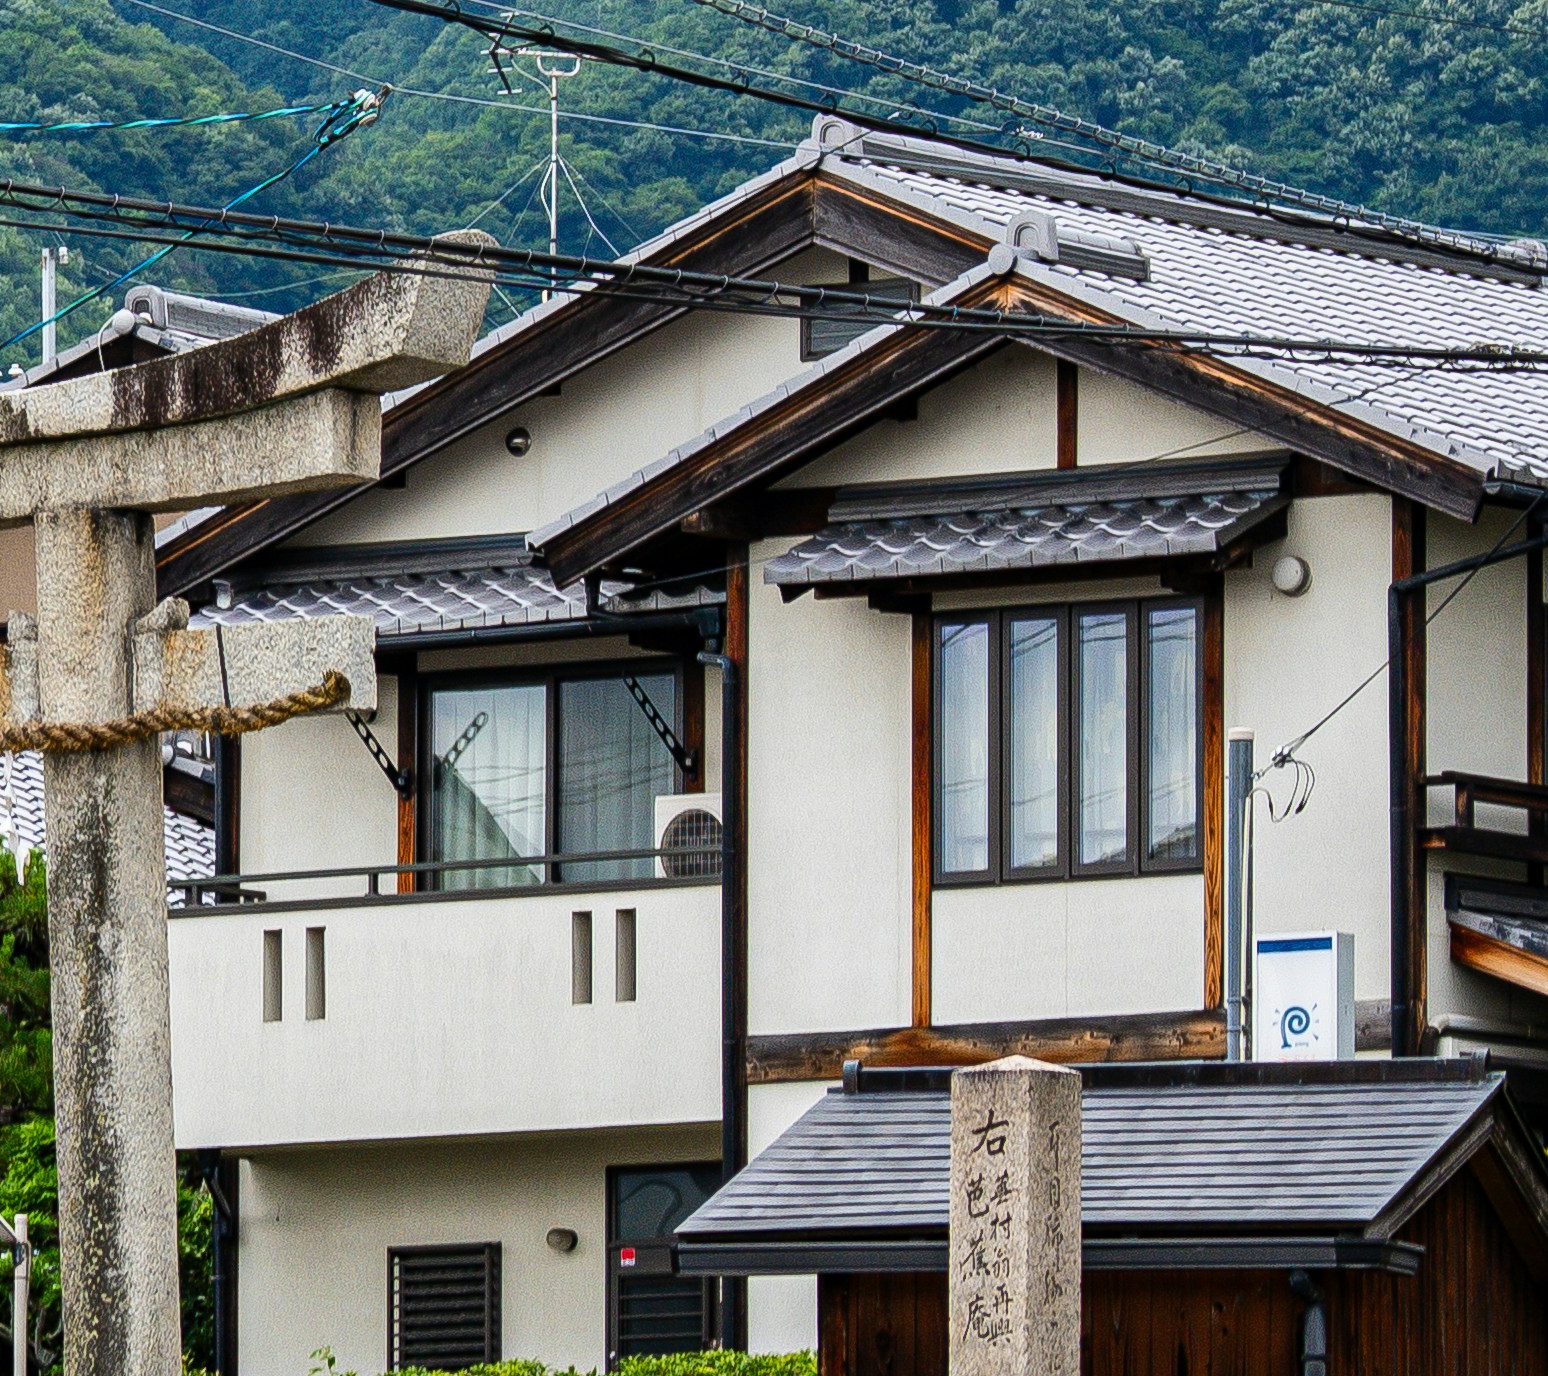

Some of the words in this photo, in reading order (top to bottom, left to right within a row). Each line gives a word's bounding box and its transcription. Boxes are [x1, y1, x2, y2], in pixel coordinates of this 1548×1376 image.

[968, 1108, 1010, 1156] 右
[958, 1173, 991, 1342] 芭蕉庵
